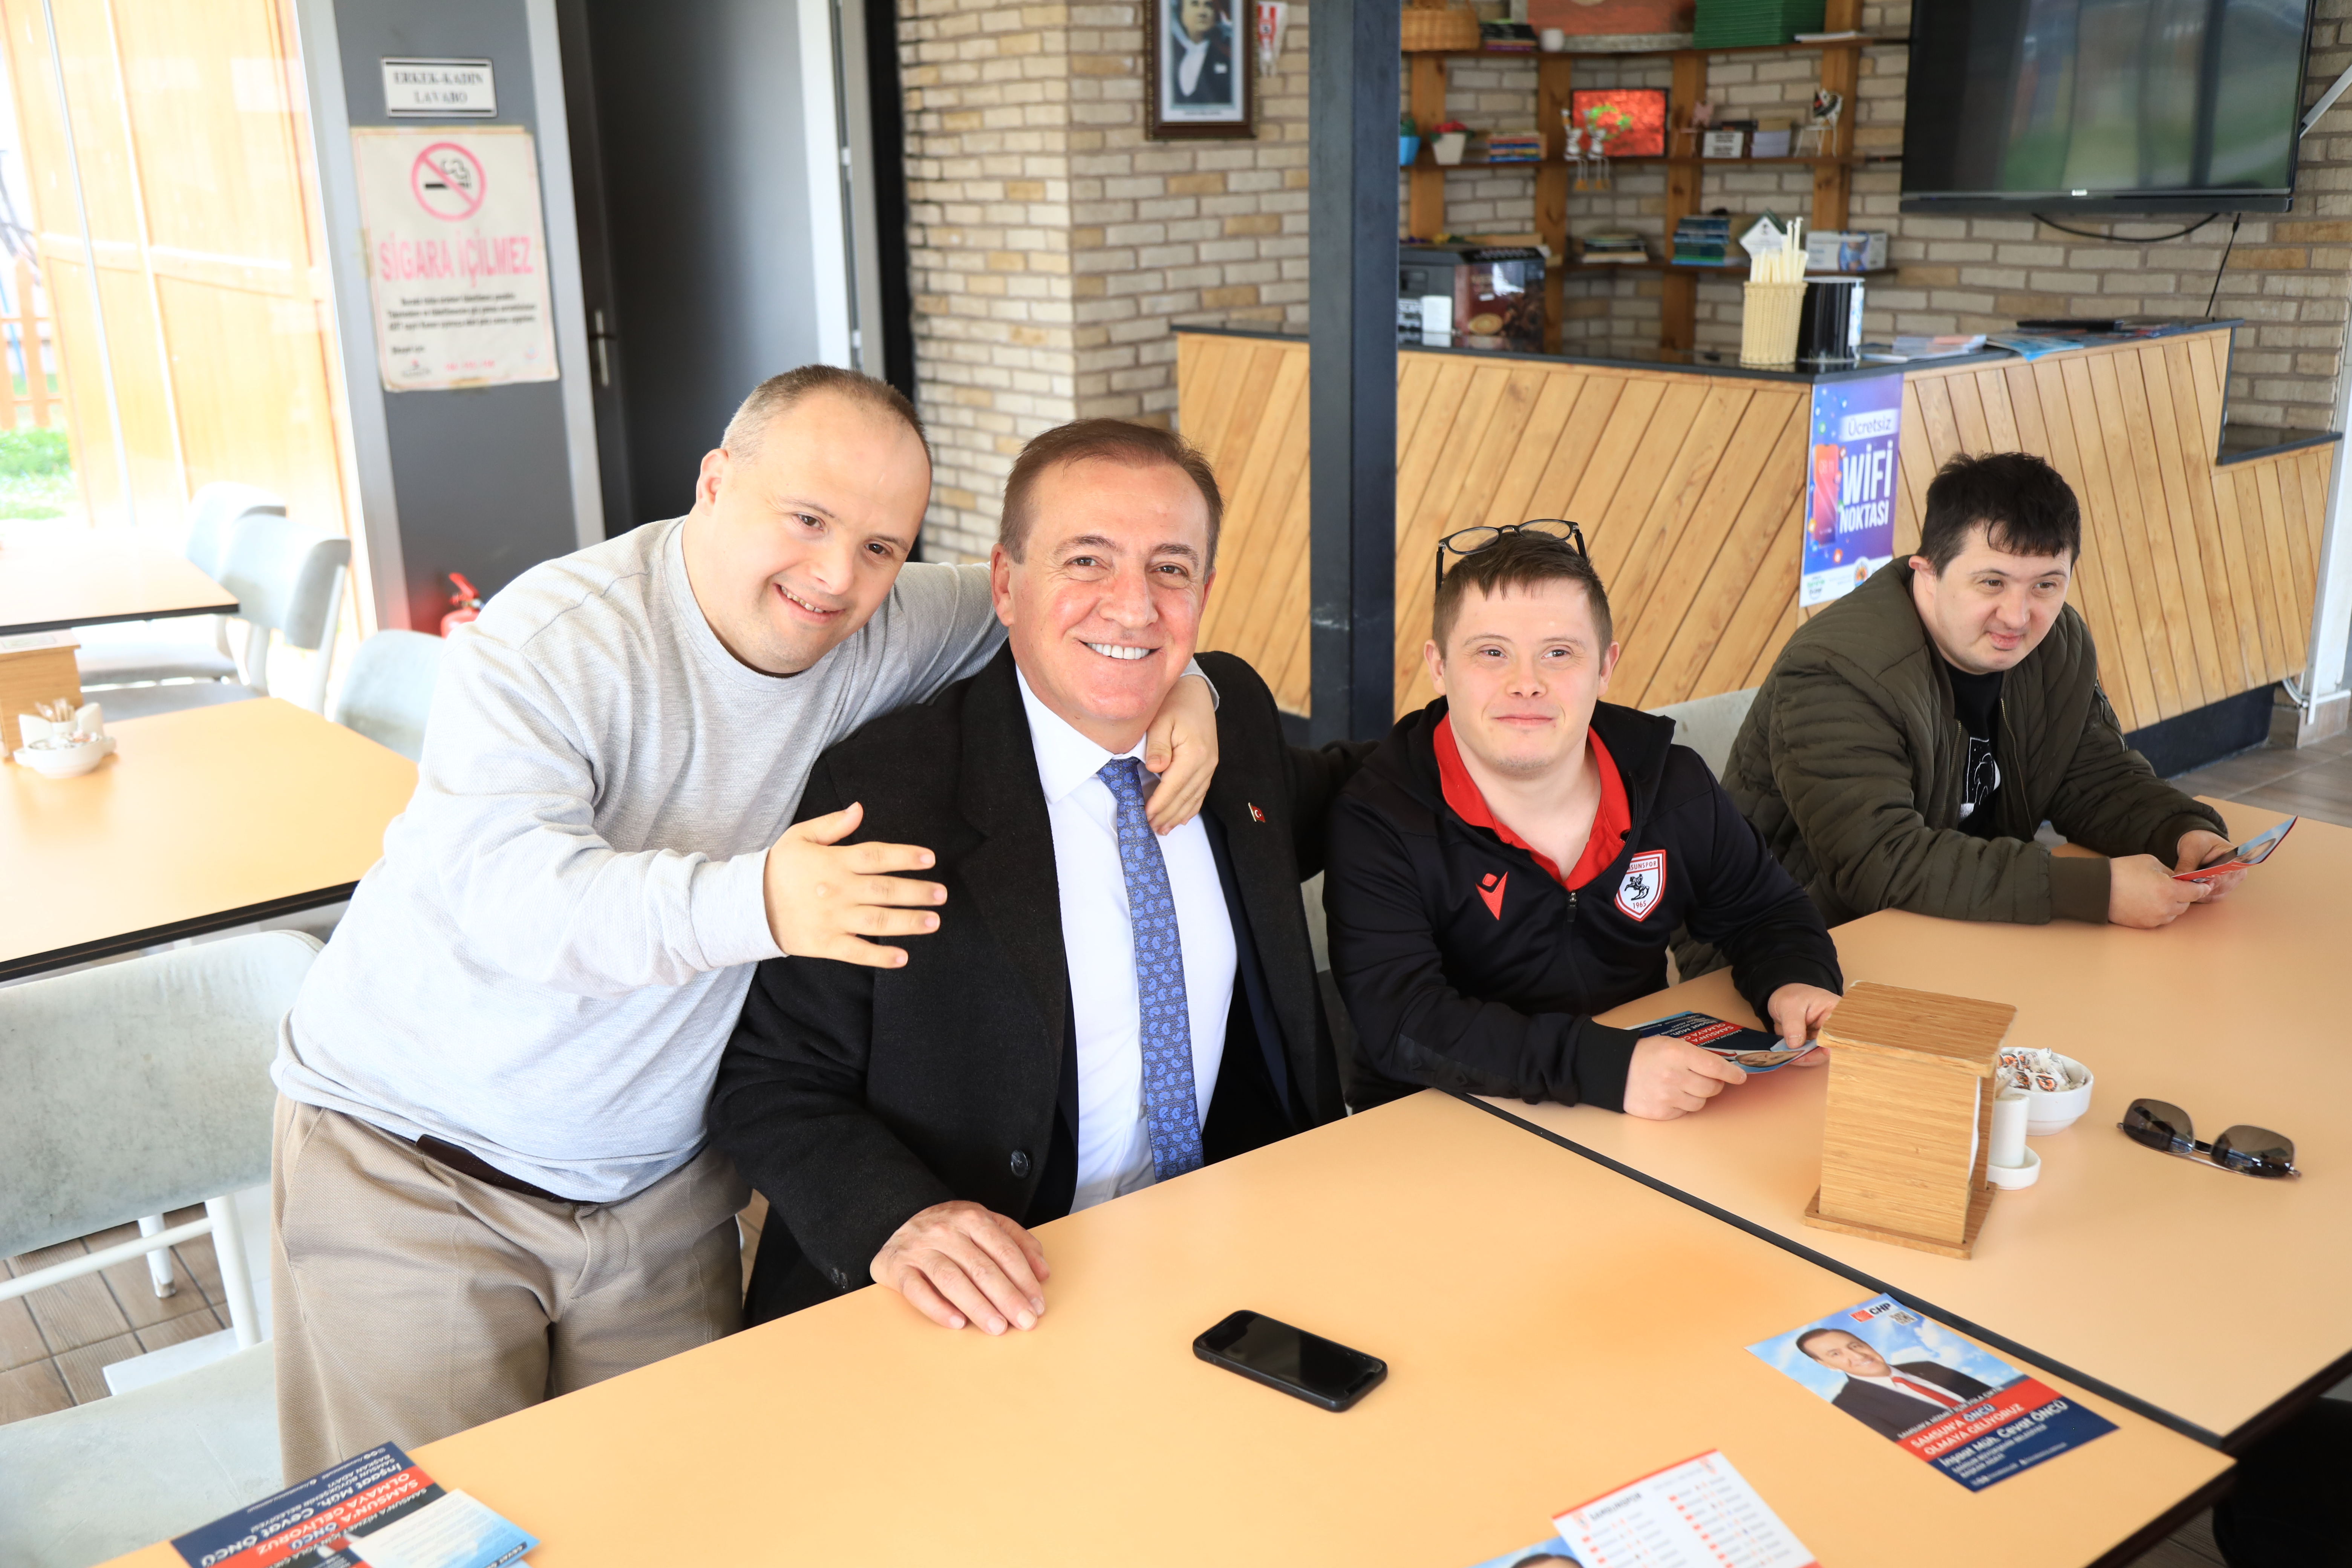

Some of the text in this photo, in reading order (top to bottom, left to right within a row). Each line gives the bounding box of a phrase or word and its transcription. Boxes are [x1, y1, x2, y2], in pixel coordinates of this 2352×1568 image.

[414, 91, 468, 104] LAVABO
[379, 228, 534, 288] SİGARA İÇİLMEZ
[1848, 415, 1891, 436] Ücretsiz
[1843, 440, 1893, 505] WİFİ
[1839, 499, 1889, 534] NOKTASI
[1633, 900, 1646, 909] 1965
[1690, 1023, 1726, 1037] OLMAYA
[1691, 1026, 1734, 1042] SAMSUN'A
[1869, 1302, 1891, 1315] CHP
[1910, 1403, 1995, 1448] SAMSUN'A ÖNCÜ
[1923, 1403, 2025, 1455] OLMAYA GELİYORUZ
[1997, 1417, 2035, 1438] Cevat
[2029, 1400, 2068, 1422] ÖNCÜ
[328, 1471, 354, 1488] ADAYI
[201, 1462, 402, 1568] İnşaat Müh. Cevat ÖNCÜ
[257, 1473, 410, 1556] OLMAYA GELİYORUZ
[292, 1479, 418, 1551] SAMSUN'A ÖNCÜ
